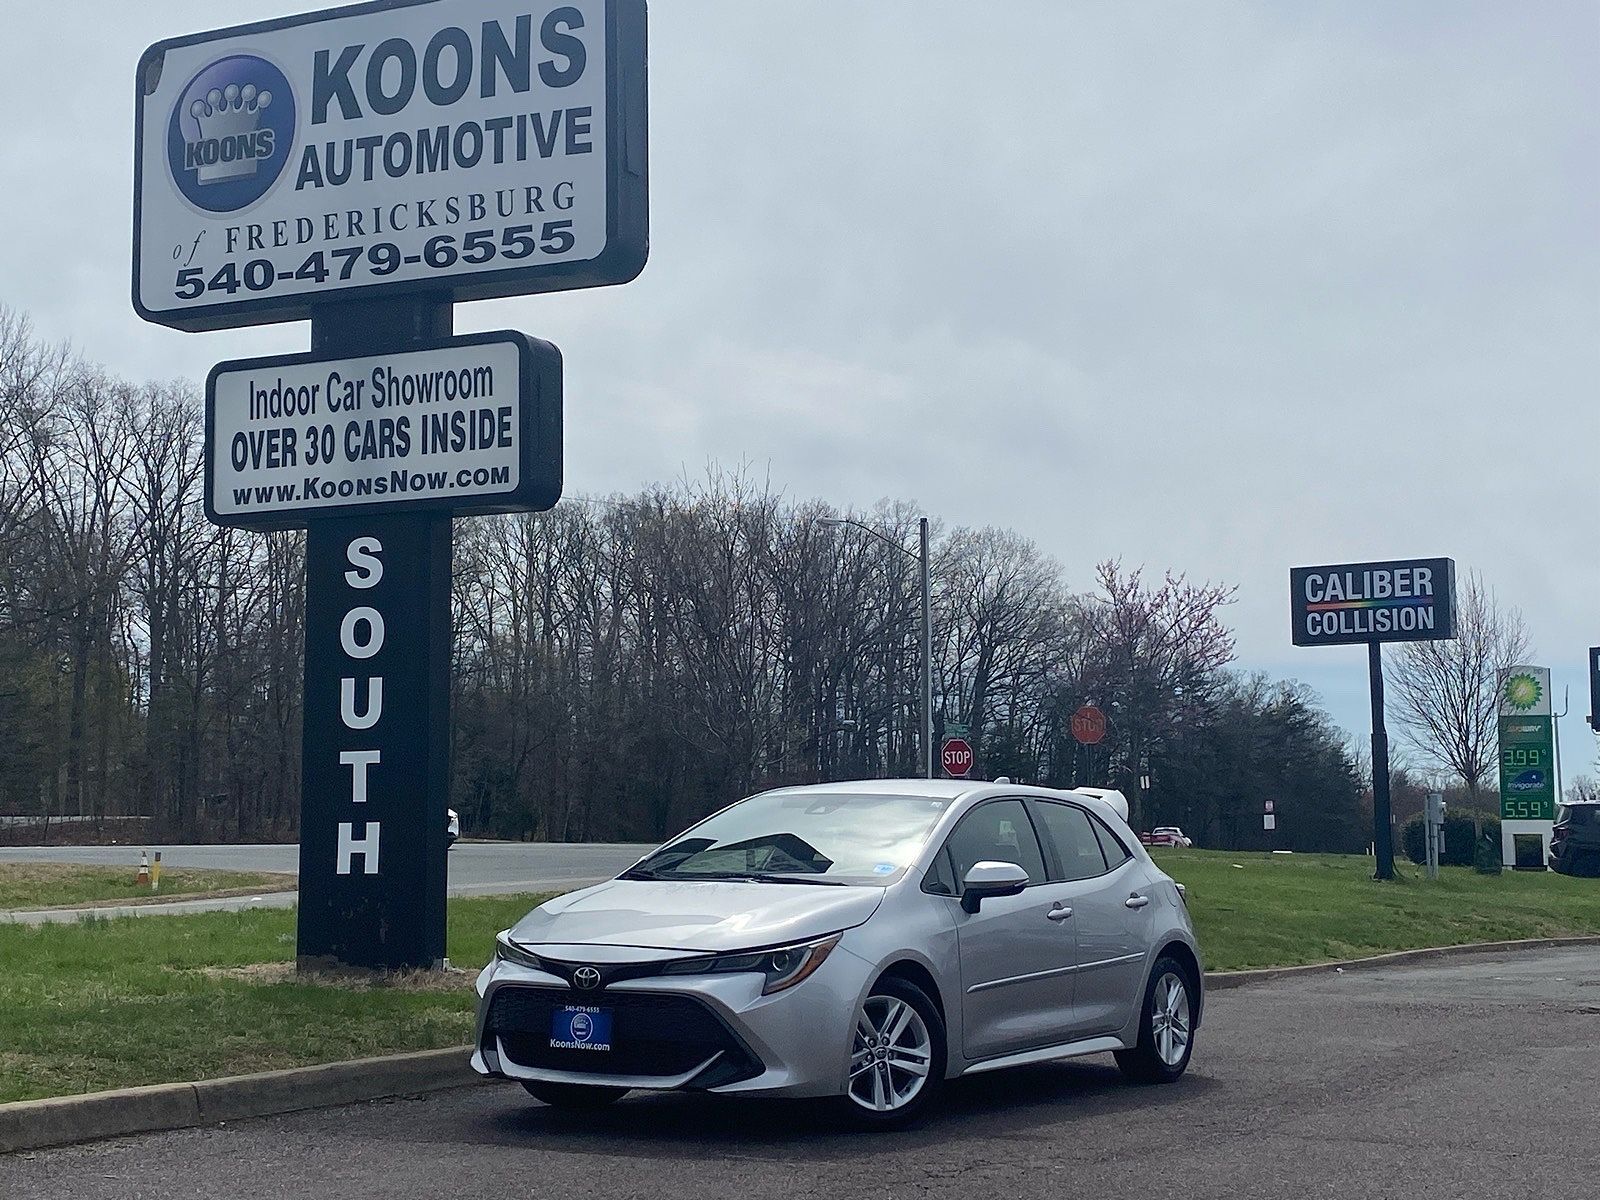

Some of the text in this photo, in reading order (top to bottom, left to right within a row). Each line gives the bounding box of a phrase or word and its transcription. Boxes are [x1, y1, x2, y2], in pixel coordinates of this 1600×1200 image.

[309, 5, 587, 125] KOONS
[185, 130, 275, 168] KOONS
[295, 105, 594, 191] AUTOMOTIVE
[172, 181, 577, 268] of FREDERICKSBURG
[174, 219, 576, 299] 540-479-6555
[248, 364, 494, 421] Indoor Car Showroom
[231, 406, 513, 473] OVER 30 CARS INSIDE
[1304, 567, 1434, 603] CALIBER
[1306, 605, 1435, 636] COLLISION
[336, 536, 386, 875] SOUTH
[944, 750, 971, 765] STOP
[1503, 749, 1539, 766] 3.99
[1505, 801, 1541, 818] 5.59
[550, 1038, 610, 1051] KoonsNow.com
